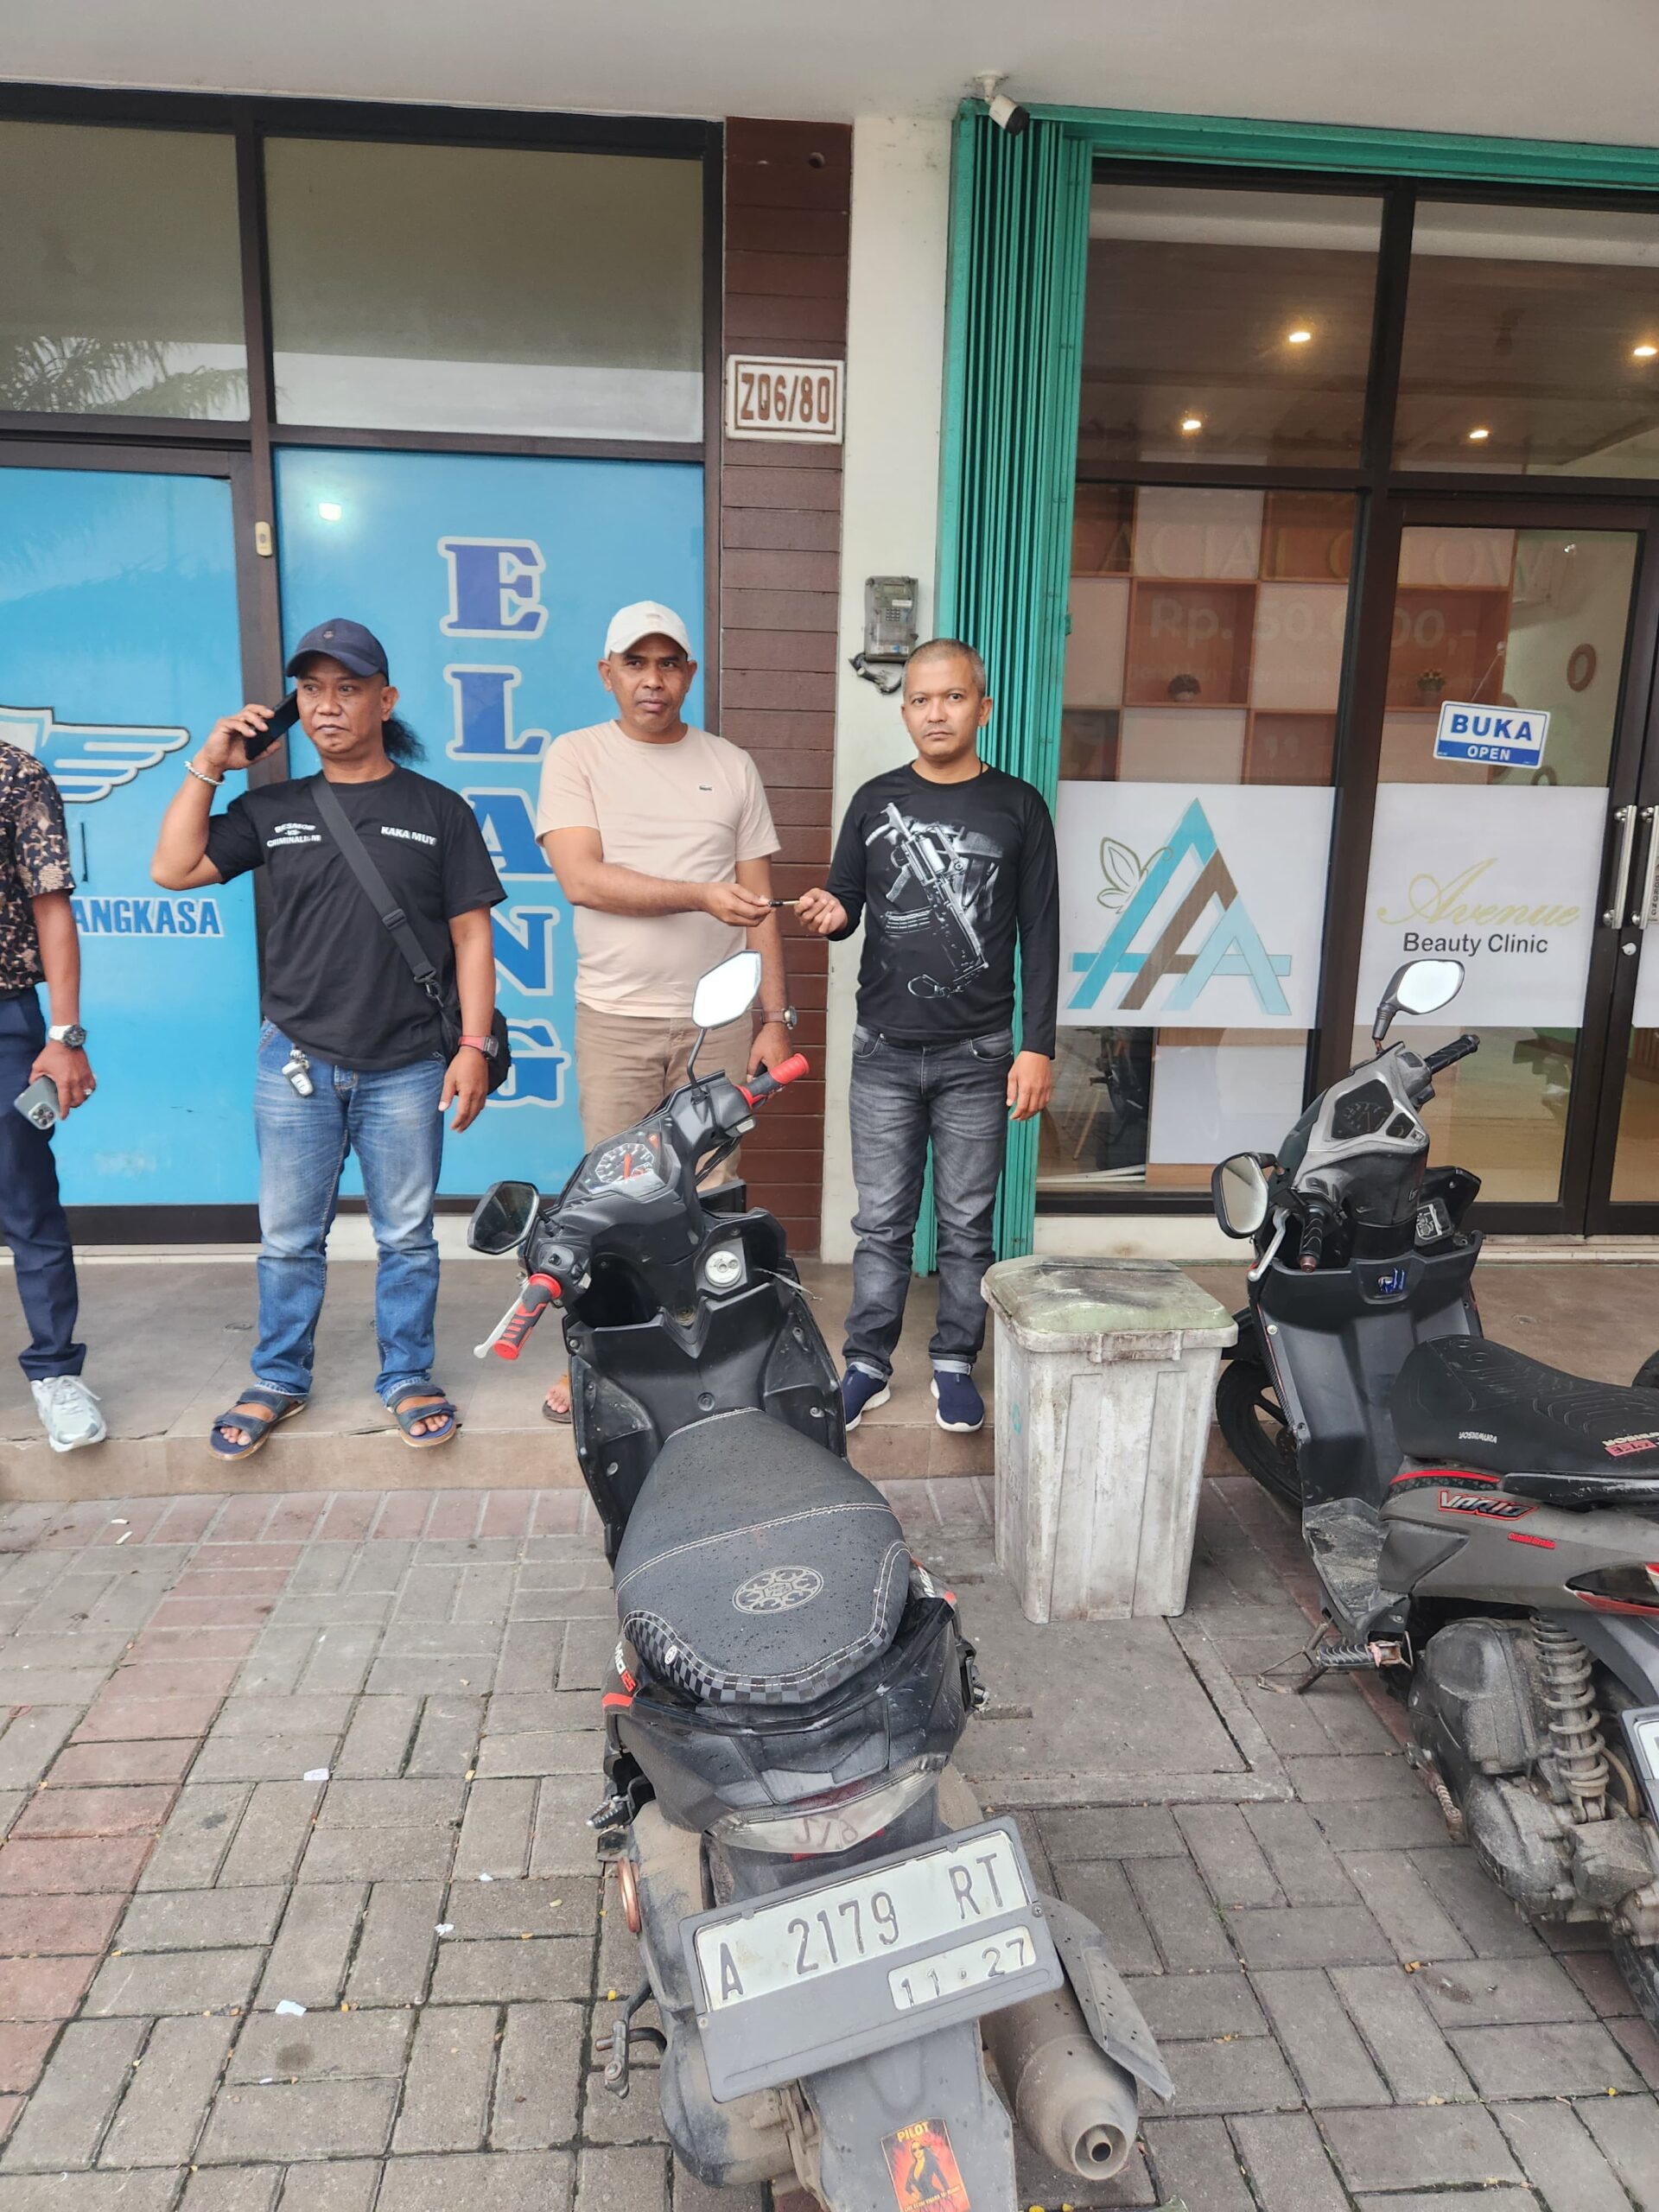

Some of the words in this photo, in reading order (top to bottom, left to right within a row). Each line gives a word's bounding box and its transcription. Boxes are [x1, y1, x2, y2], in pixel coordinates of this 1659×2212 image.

[1451, 714, 1532, 741] BUKA
[1467, 746, 1510, 761] OPEN
[381, 826, 410, 839] KAKA
[411, 831, 436, 846] MUY
[1376, 857, 1580, 926] Avenue
[1403, 932, 1482, 957] Beauty
[1488, 934, 1548, 953] Clinic
[1439, 1490, 1535, 1518] VARIO
[719, 1942, 744, 2001] A
[787, 1891, 900, 1975] 2179
[949, 1853, 1004, 1920] RT
[896, 2121, 929, 2143] PILOT
